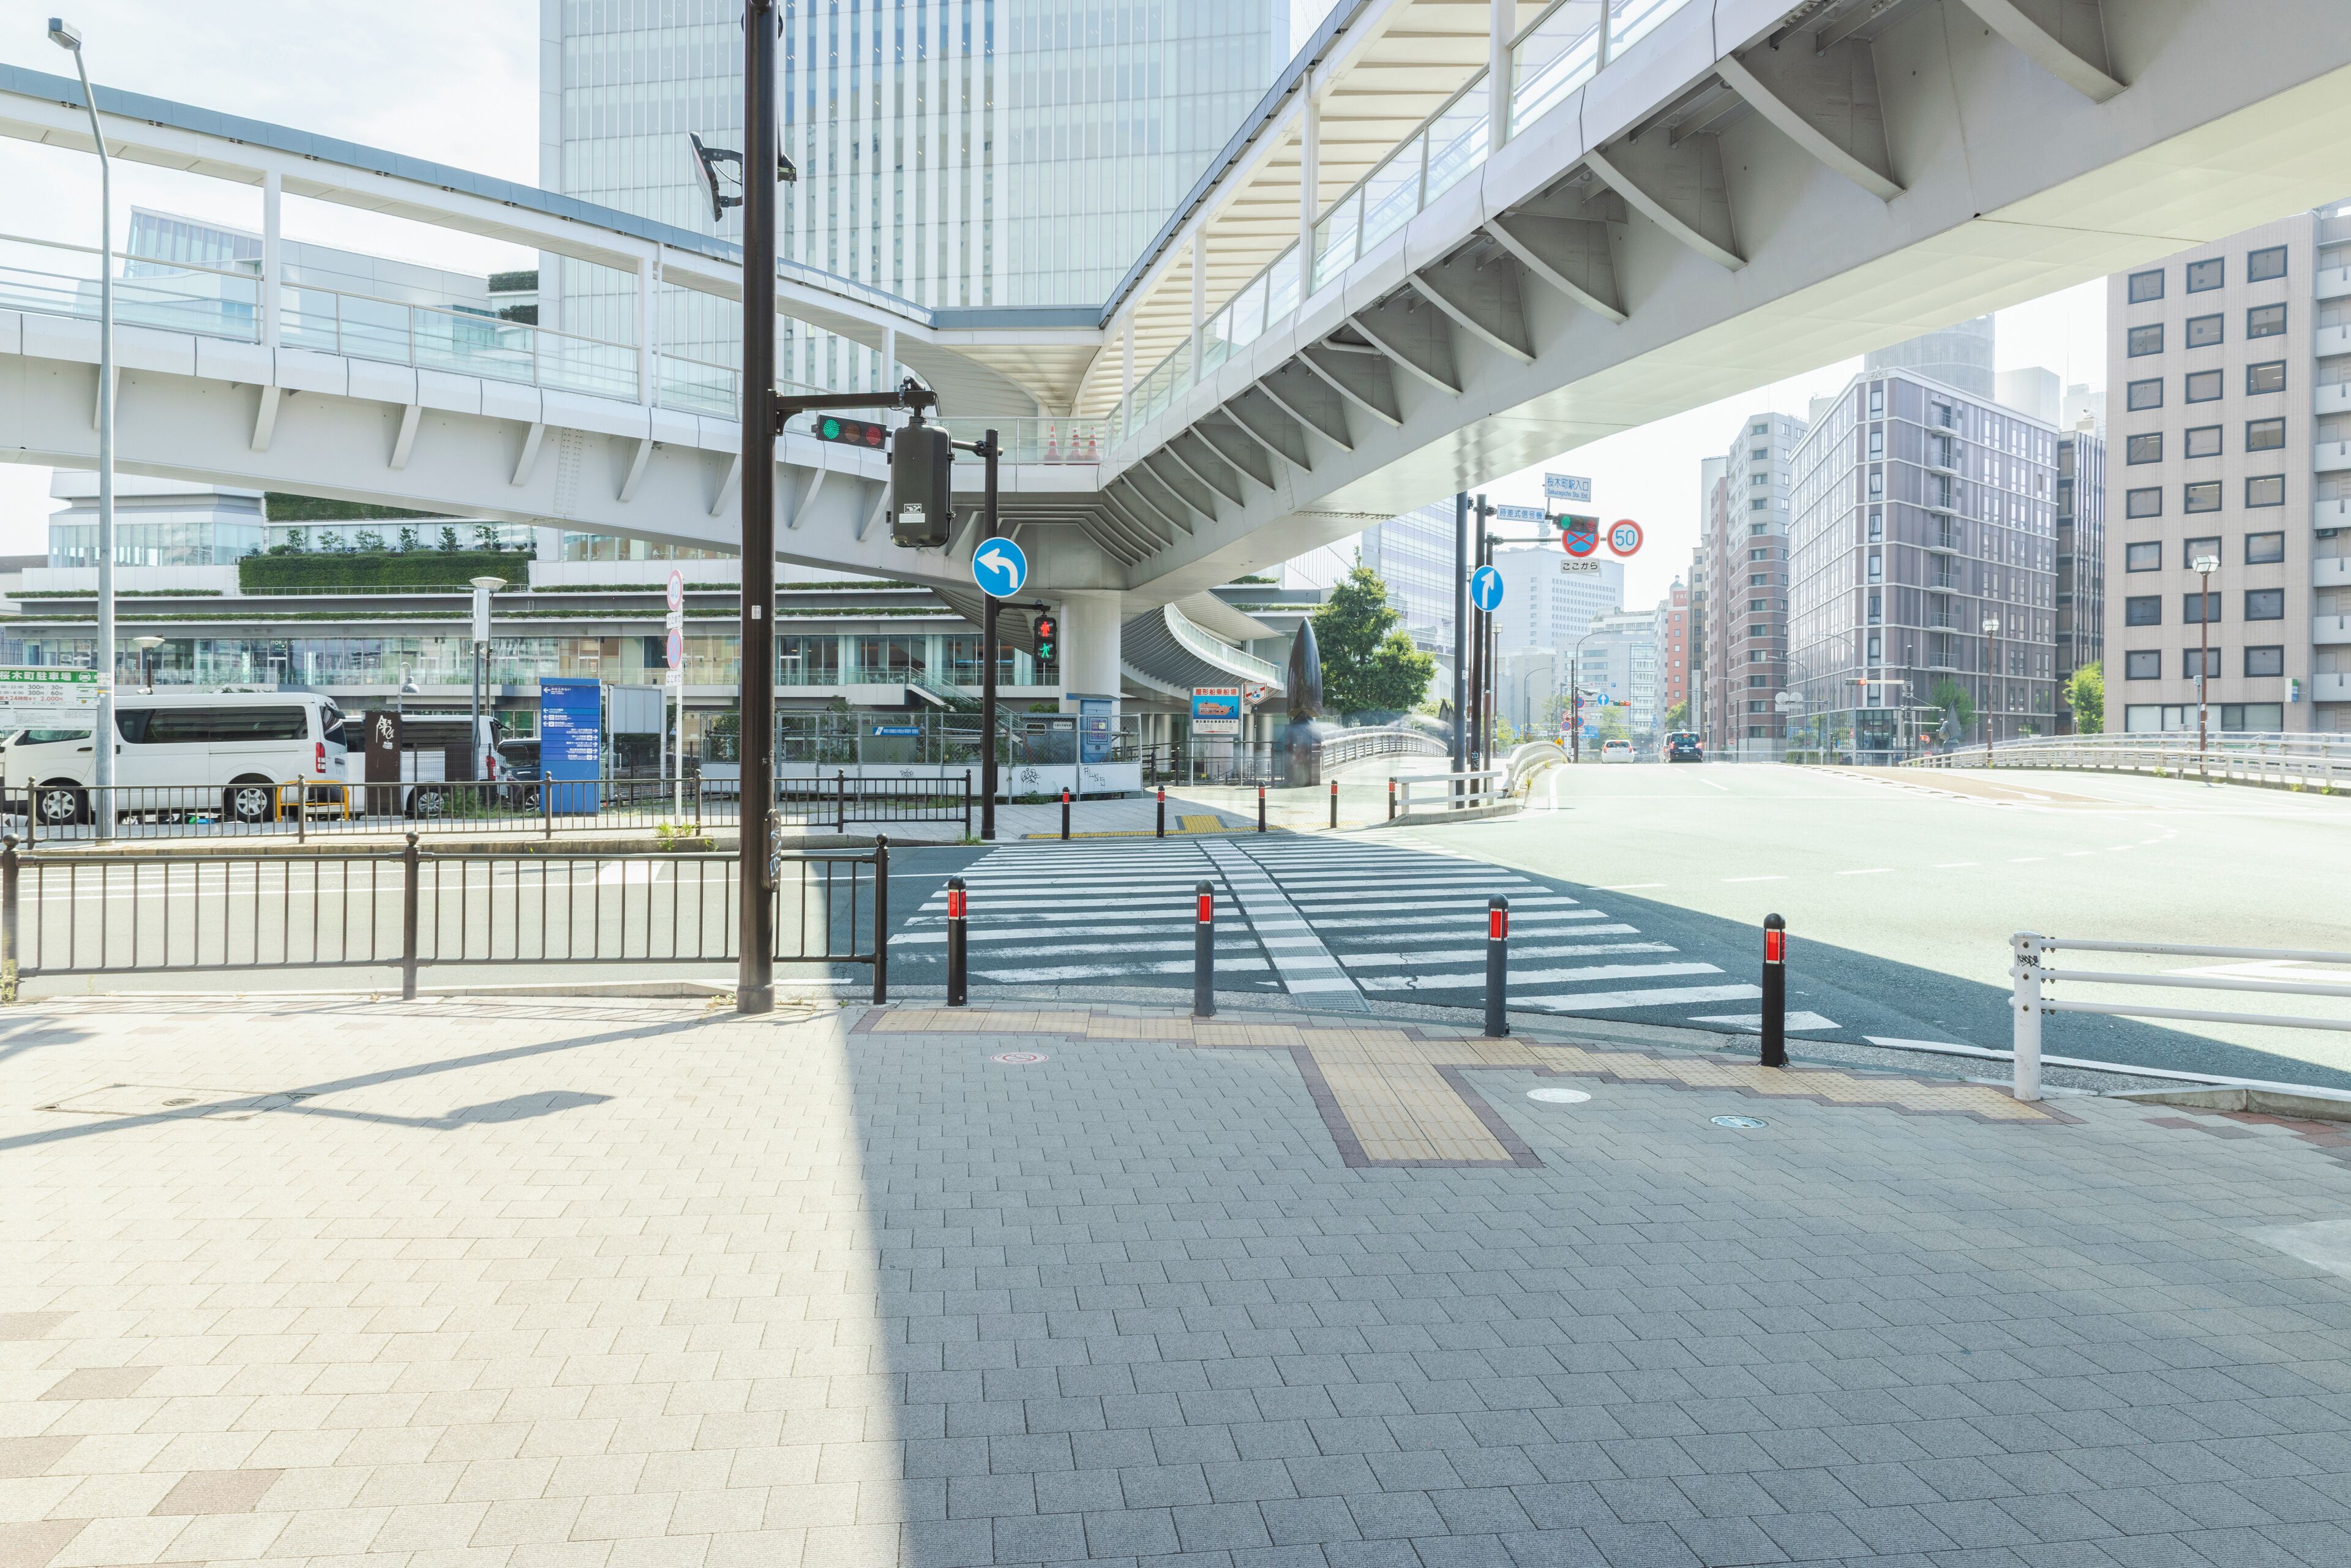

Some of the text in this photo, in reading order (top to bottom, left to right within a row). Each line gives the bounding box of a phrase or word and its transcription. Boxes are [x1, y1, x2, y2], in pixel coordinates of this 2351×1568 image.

[1547, 476, 1589, 491] 桜木町駅入口
[1500, 508, 1543, 520] 時差式信号機
[1615, 530, 1635, 546] 50
[670, 581, 679, 598] 40
[667, 614, 681, 625] ここまで
[0, 672, 72, 681] 桜木町駐車場
[667, 674, 681, 683] ここまで
